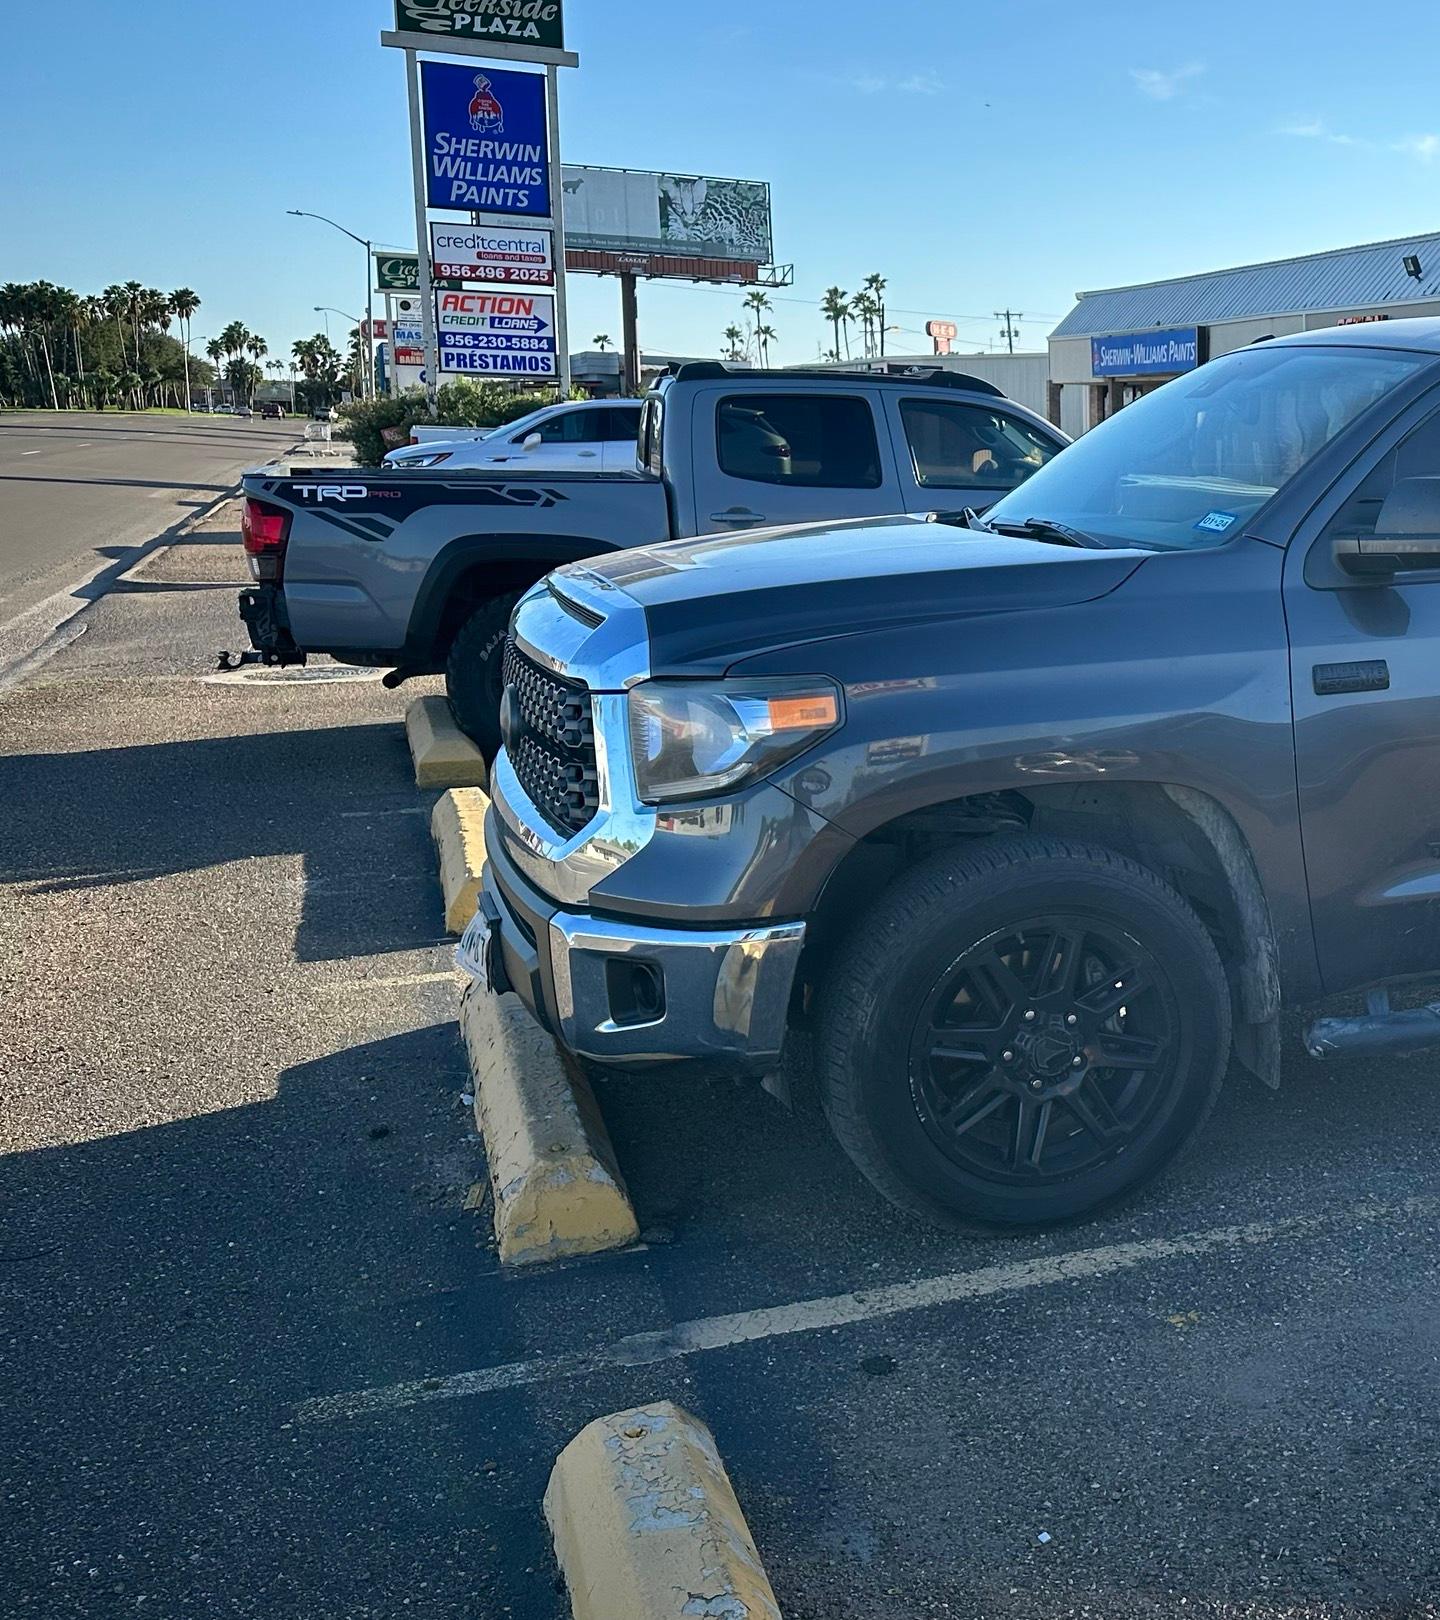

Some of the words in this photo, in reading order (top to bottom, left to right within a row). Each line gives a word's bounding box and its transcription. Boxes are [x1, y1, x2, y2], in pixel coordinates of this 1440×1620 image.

[453, 13, 541, 39] PLAZA
[433, 132, 541, 163] SHERWIN
[432, 155, 543, 186] WILLIAMS
[450, 180, 529, 207] PAINTS
[436, 233, 545, 254] creditcentral
[481, 252, 503, 260] loans
[441, 264, 506, 279] 956.496
[510, 269, 549, 281] 2025
[442, 294, 534, 315] ACTION
[442, 315, 488, 326] CREDIT
[494, 318, 538, 329] LOANS
[445, 334, 549, 350] 956-230-5884
[444, 350, 552, 372] PRÉSTAMOS
[1100, 343, 1168, 367] SHERWIN-WILLIAMS
[1169, 340, 1195, 362] PAINTS
[292, 485, 368, 502] TRD
[368, 490, 401, 498] PRO
